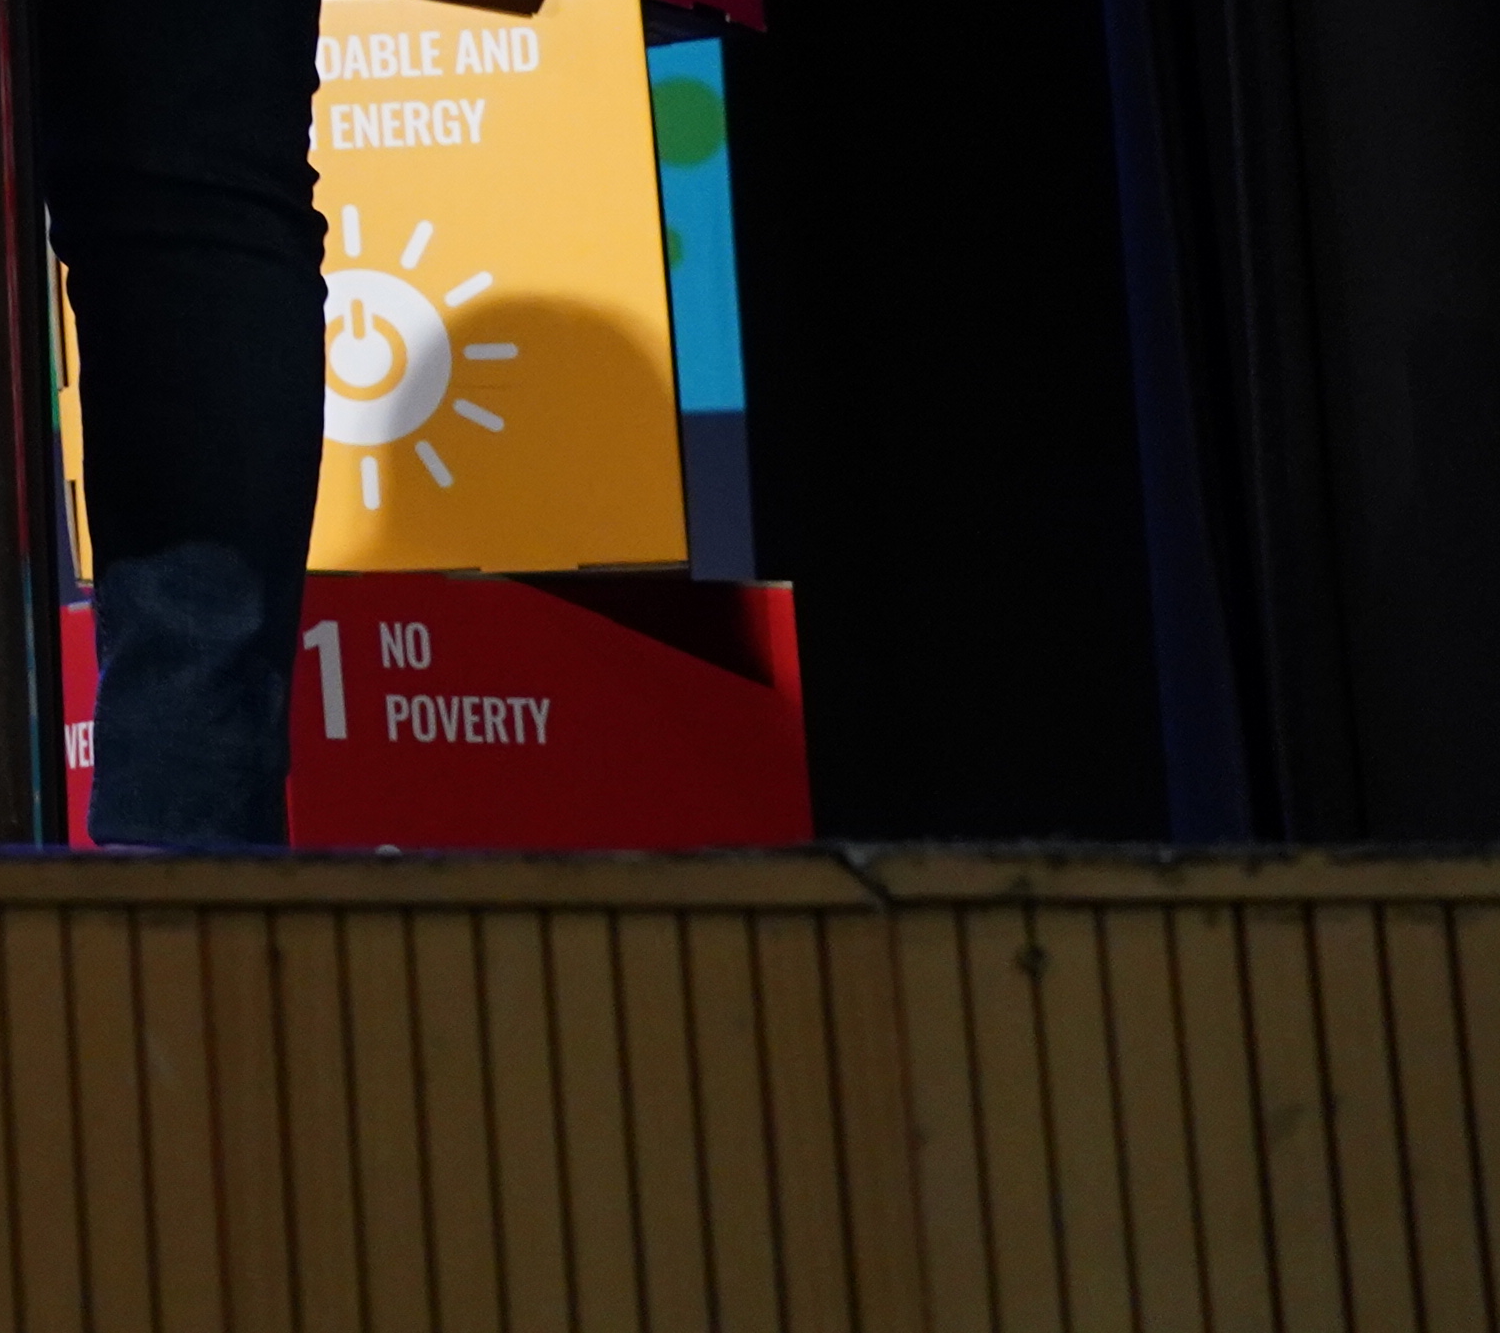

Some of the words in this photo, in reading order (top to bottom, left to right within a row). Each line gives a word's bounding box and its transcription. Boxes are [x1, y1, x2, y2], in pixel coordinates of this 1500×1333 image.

[315, 31, 442, 82] DABLE
[456, 27, 539, 75] AND
[330, 98, 486, 150] ENERGY
[303, 619, 347, 739] 1
[380, 621, 432, 669] NO
[385, 695, 551, 745] POVERTY
